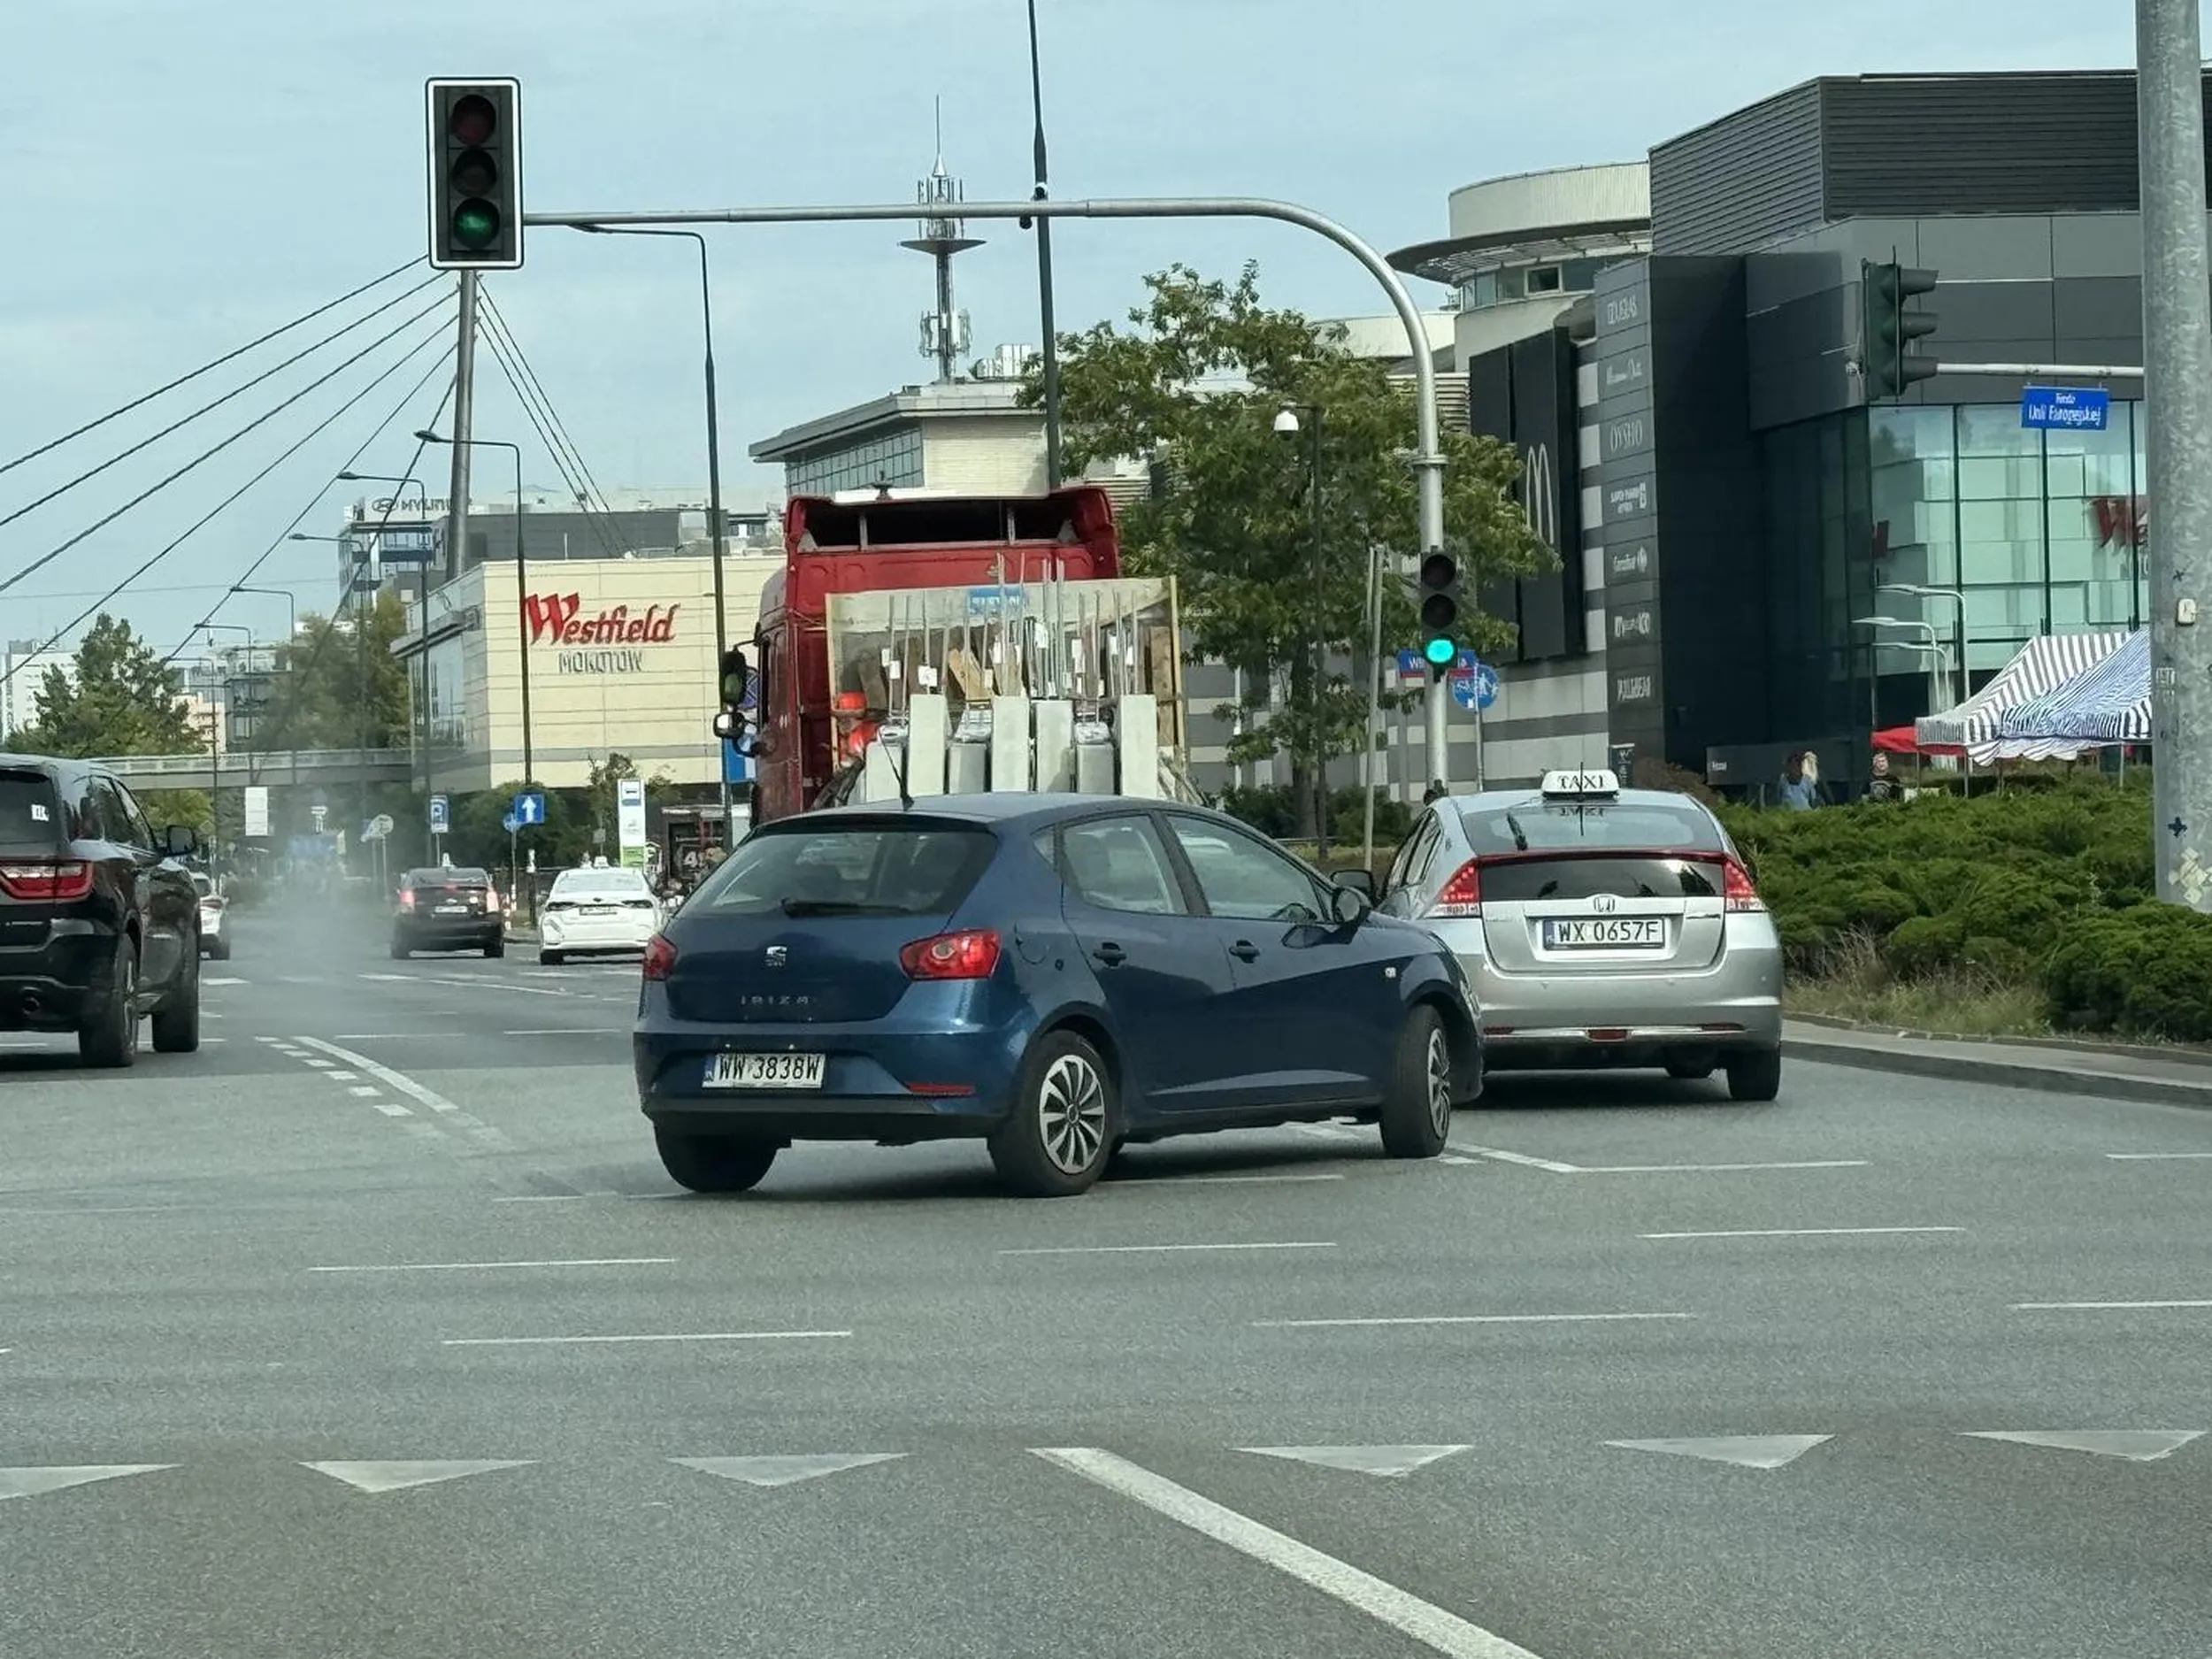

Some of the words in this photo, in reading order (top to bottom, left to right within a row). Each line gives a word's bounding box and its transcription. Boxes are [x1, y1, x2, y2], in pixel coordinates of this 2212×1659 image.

[525, 592, 680, 646] Westfield
[1558, 774, 1604, 789] TAXI
[1558, 922, 1586, 942] WX
[1594, 921, 1659, 941] 0657F
[719, 1056, 746, 1079] WW
[752, 1055, 819, 1080] 3838W
